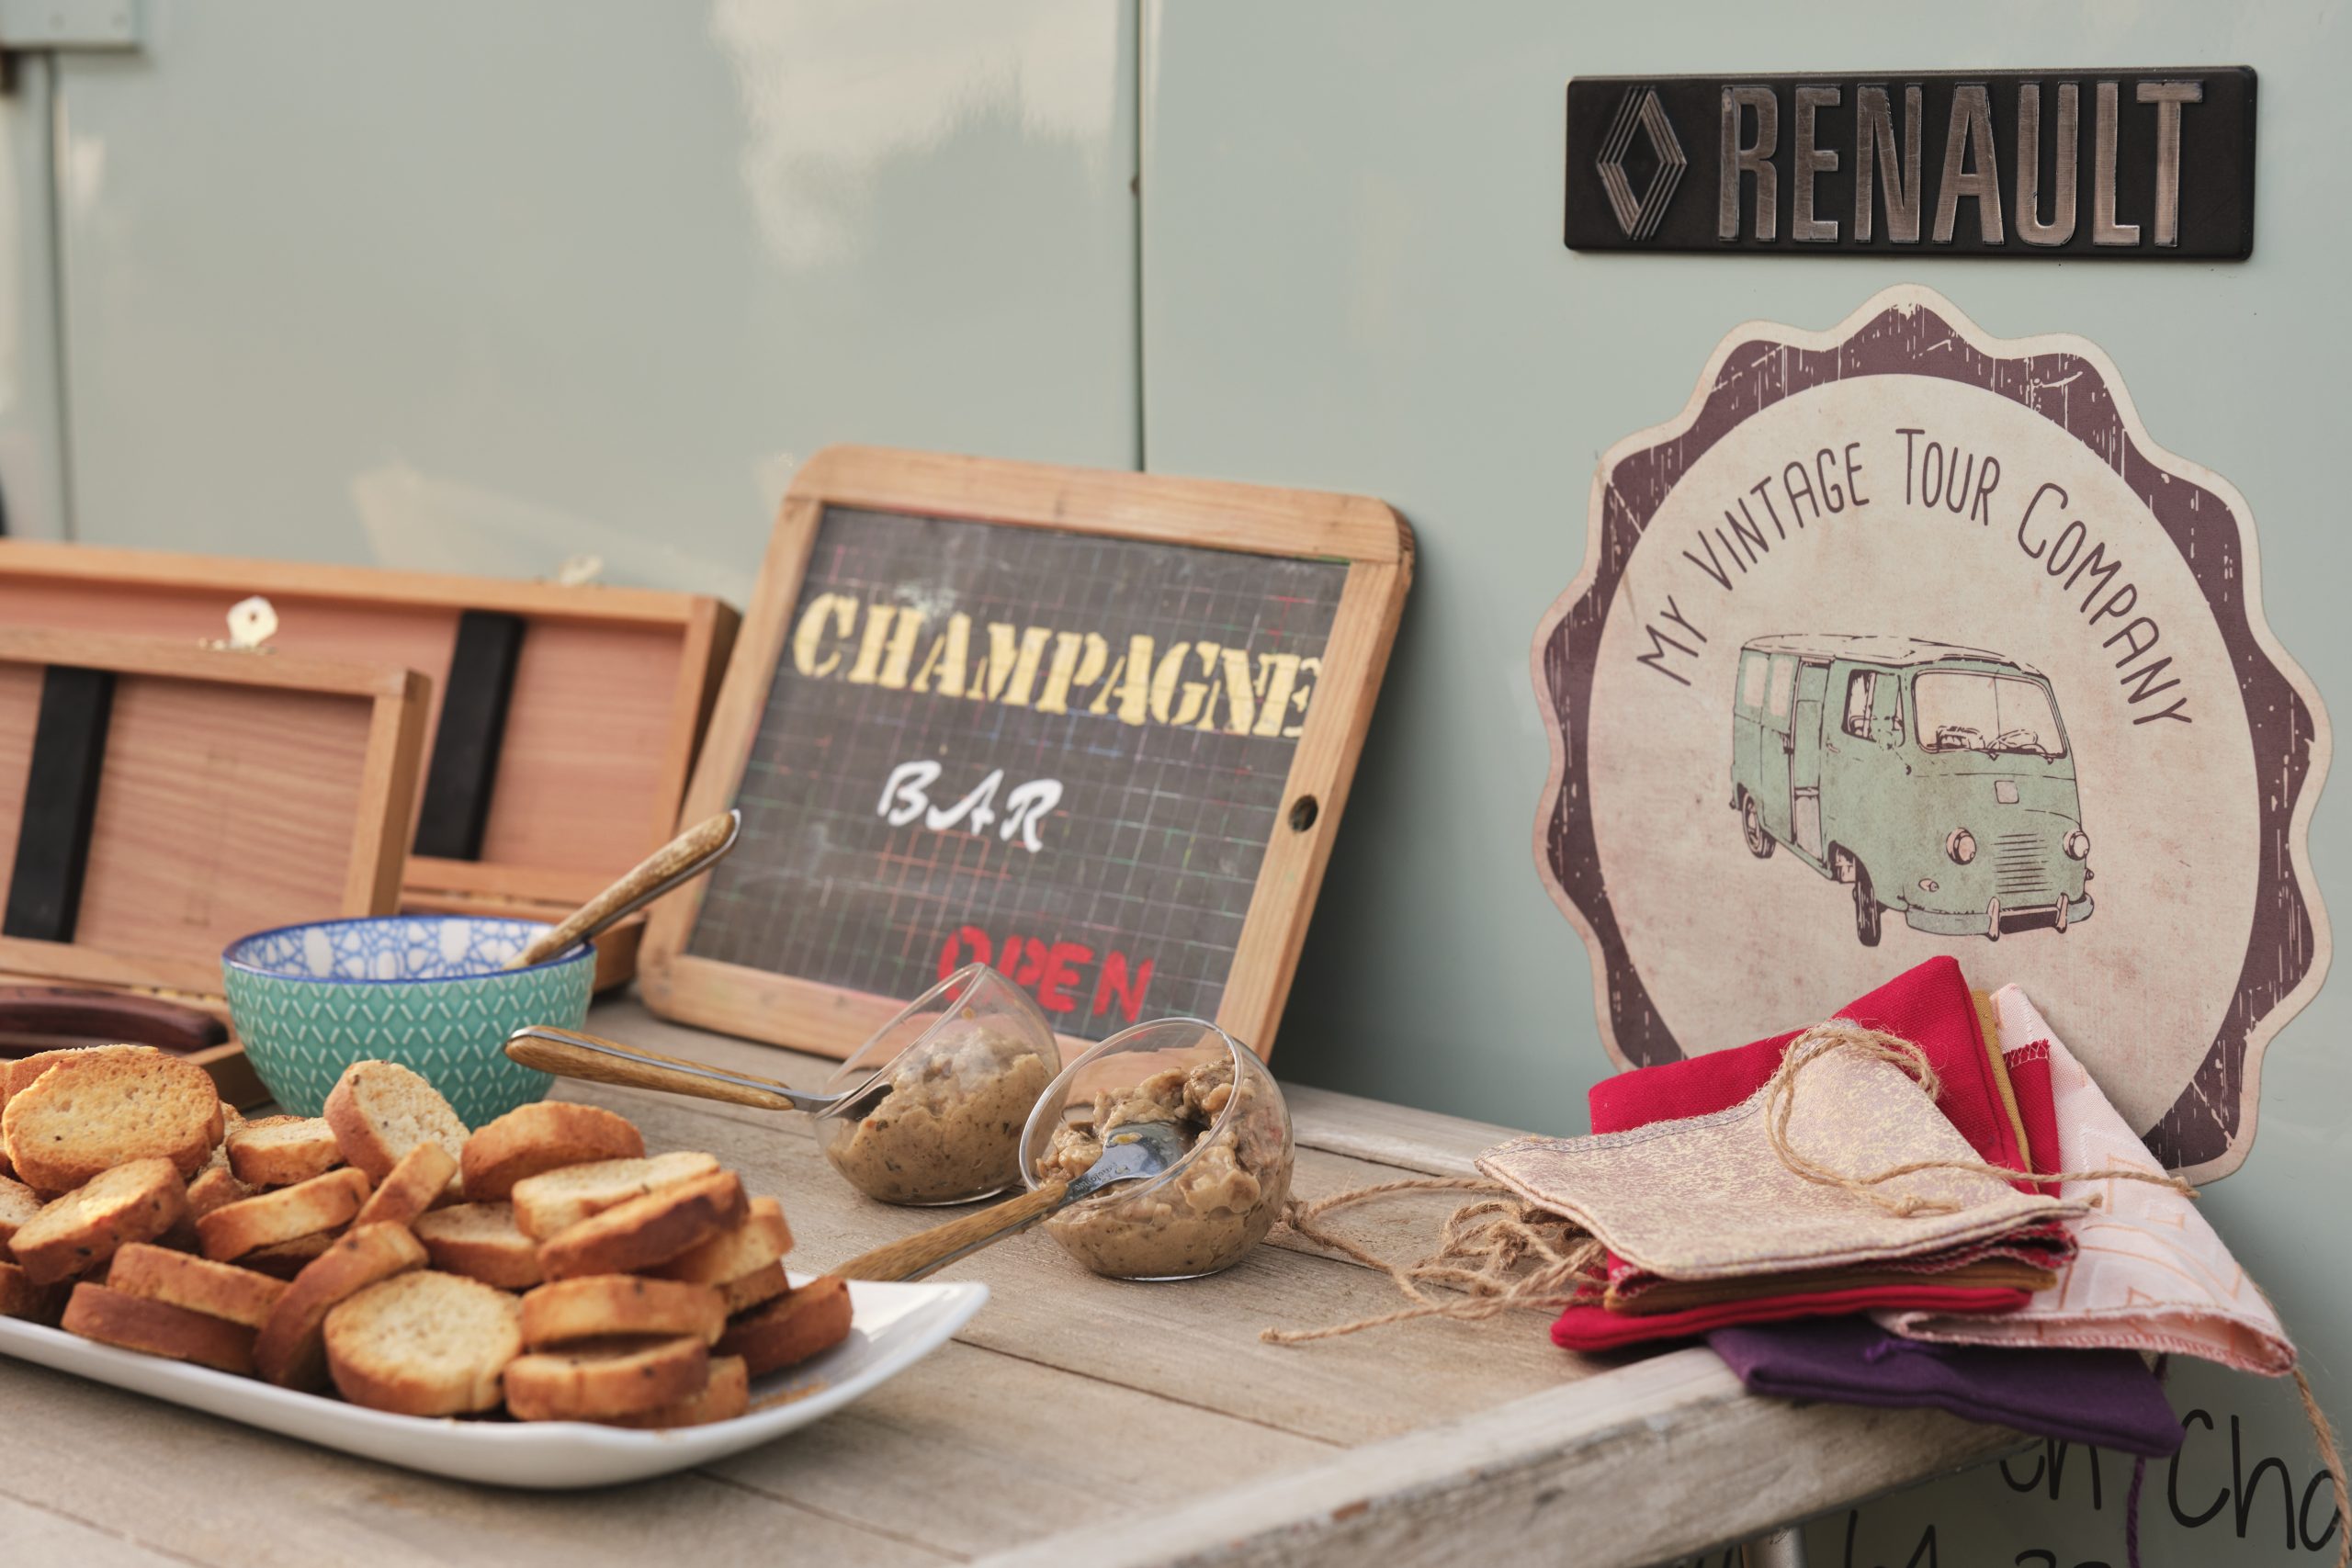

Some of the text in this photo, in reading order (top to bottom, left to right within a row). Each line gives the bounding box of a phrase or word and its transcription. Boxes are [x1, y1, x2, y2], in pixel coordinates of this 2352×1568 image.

[1717, 80, 2204, 249] RENAULT
[1636, 428, 2193, 726] MY VINTAGE TOUR COMPANY
[793, 592, 1322, 738] CHAMPAGNE
[877, 760, 1063, 852] BAR
[937, 925, 1155, 1023] OPEN
